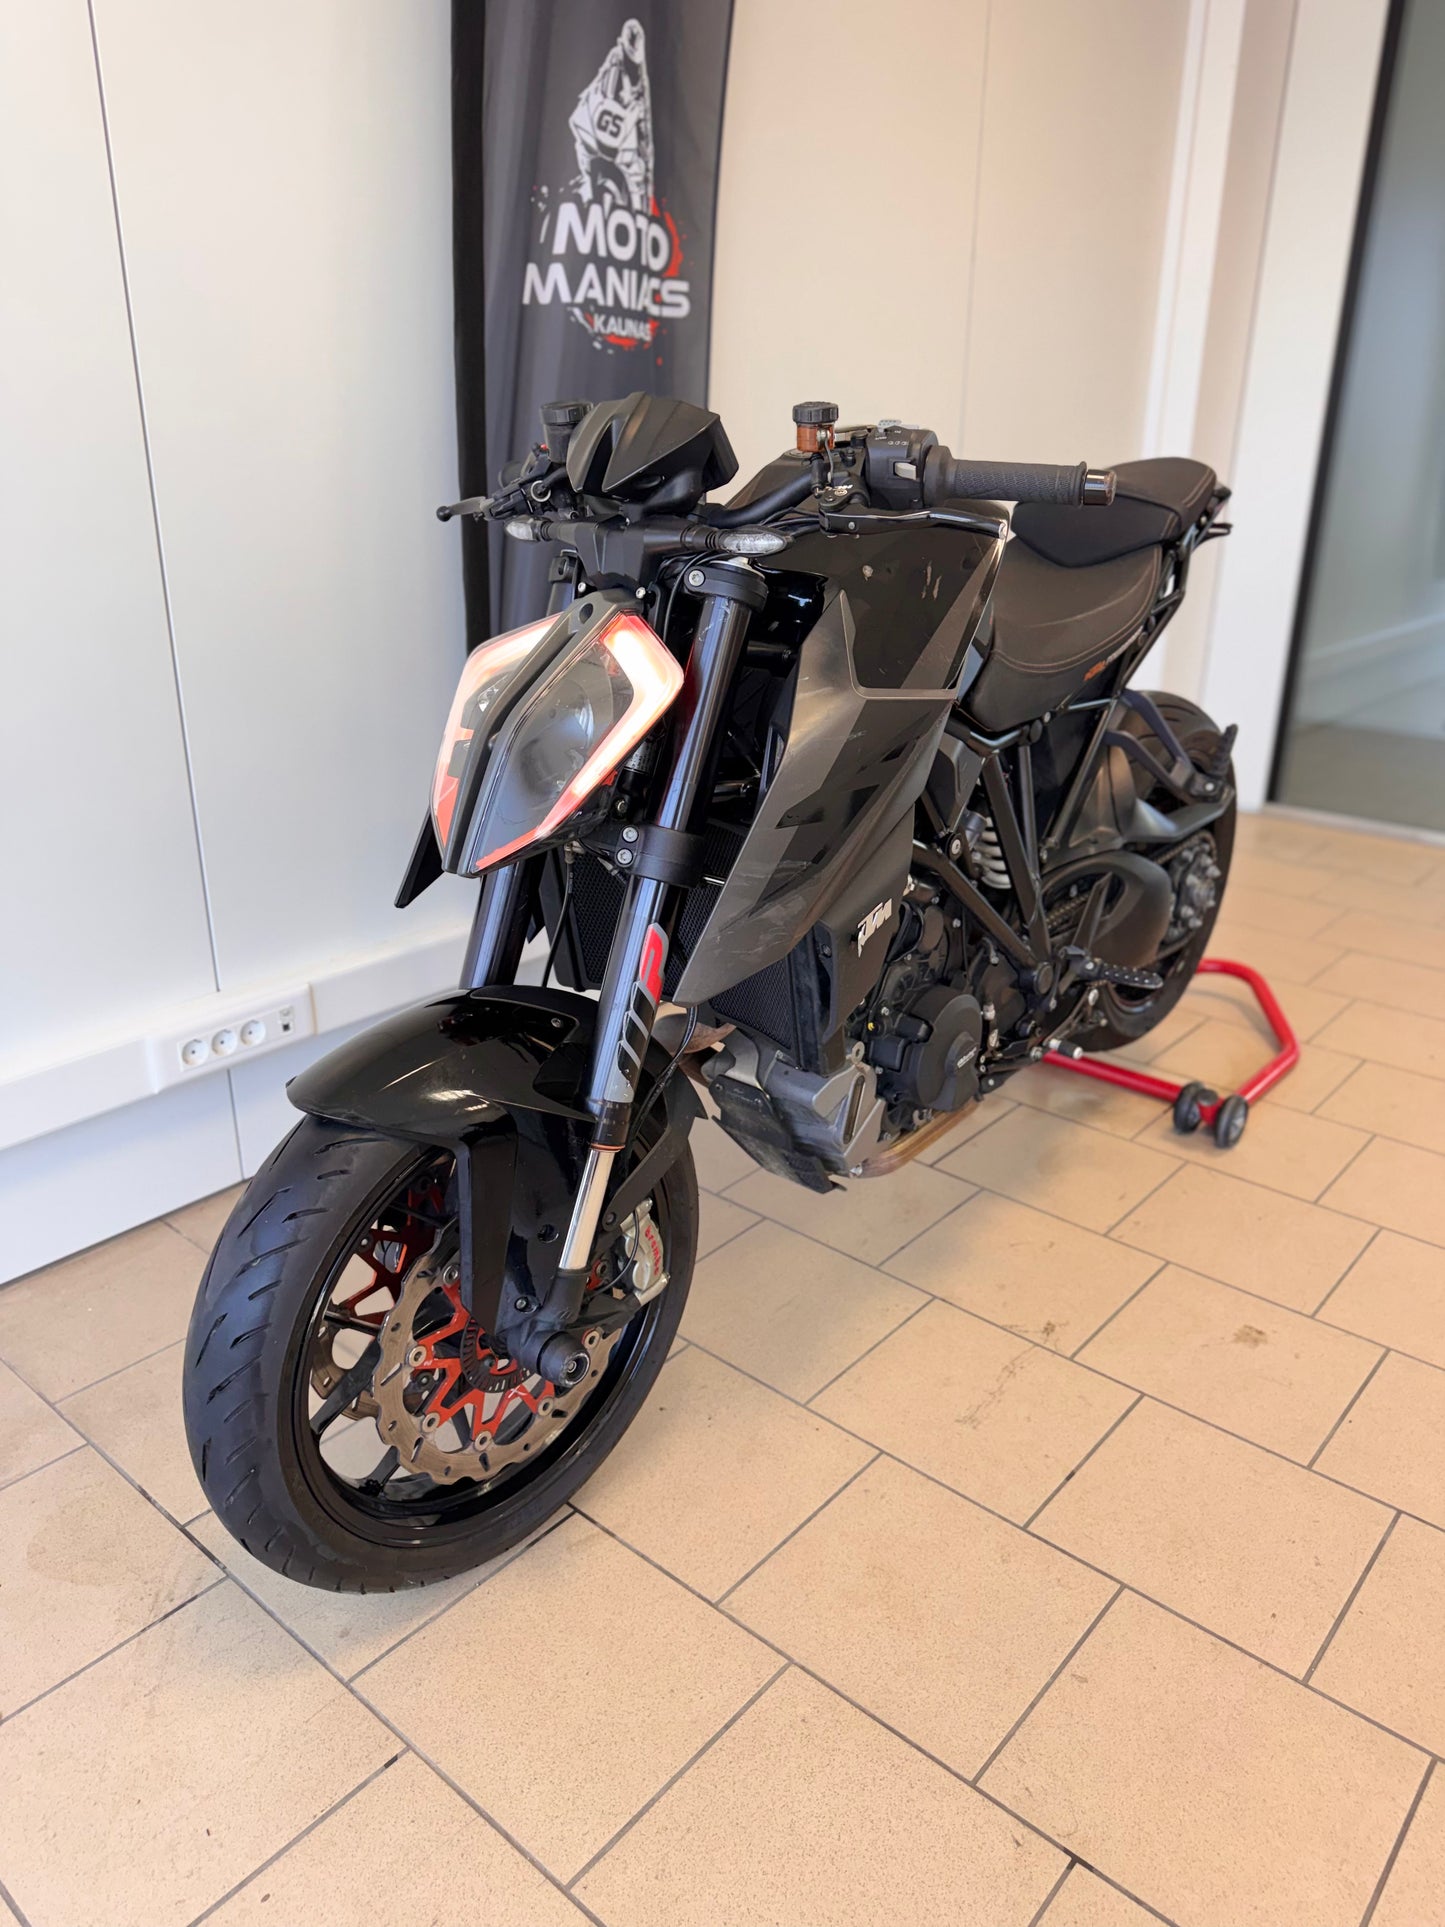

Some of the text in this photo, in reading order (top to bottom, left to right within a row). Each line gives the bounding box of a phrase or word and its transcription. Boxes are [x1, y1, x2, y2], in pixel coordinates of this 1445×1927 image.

[552, 202, 670, 272] MOTO
[522, 262, 691, 318] MANIACS
[594, 313, 651, 342] KAUNAS
[857, 898, 892, 958] KTM
